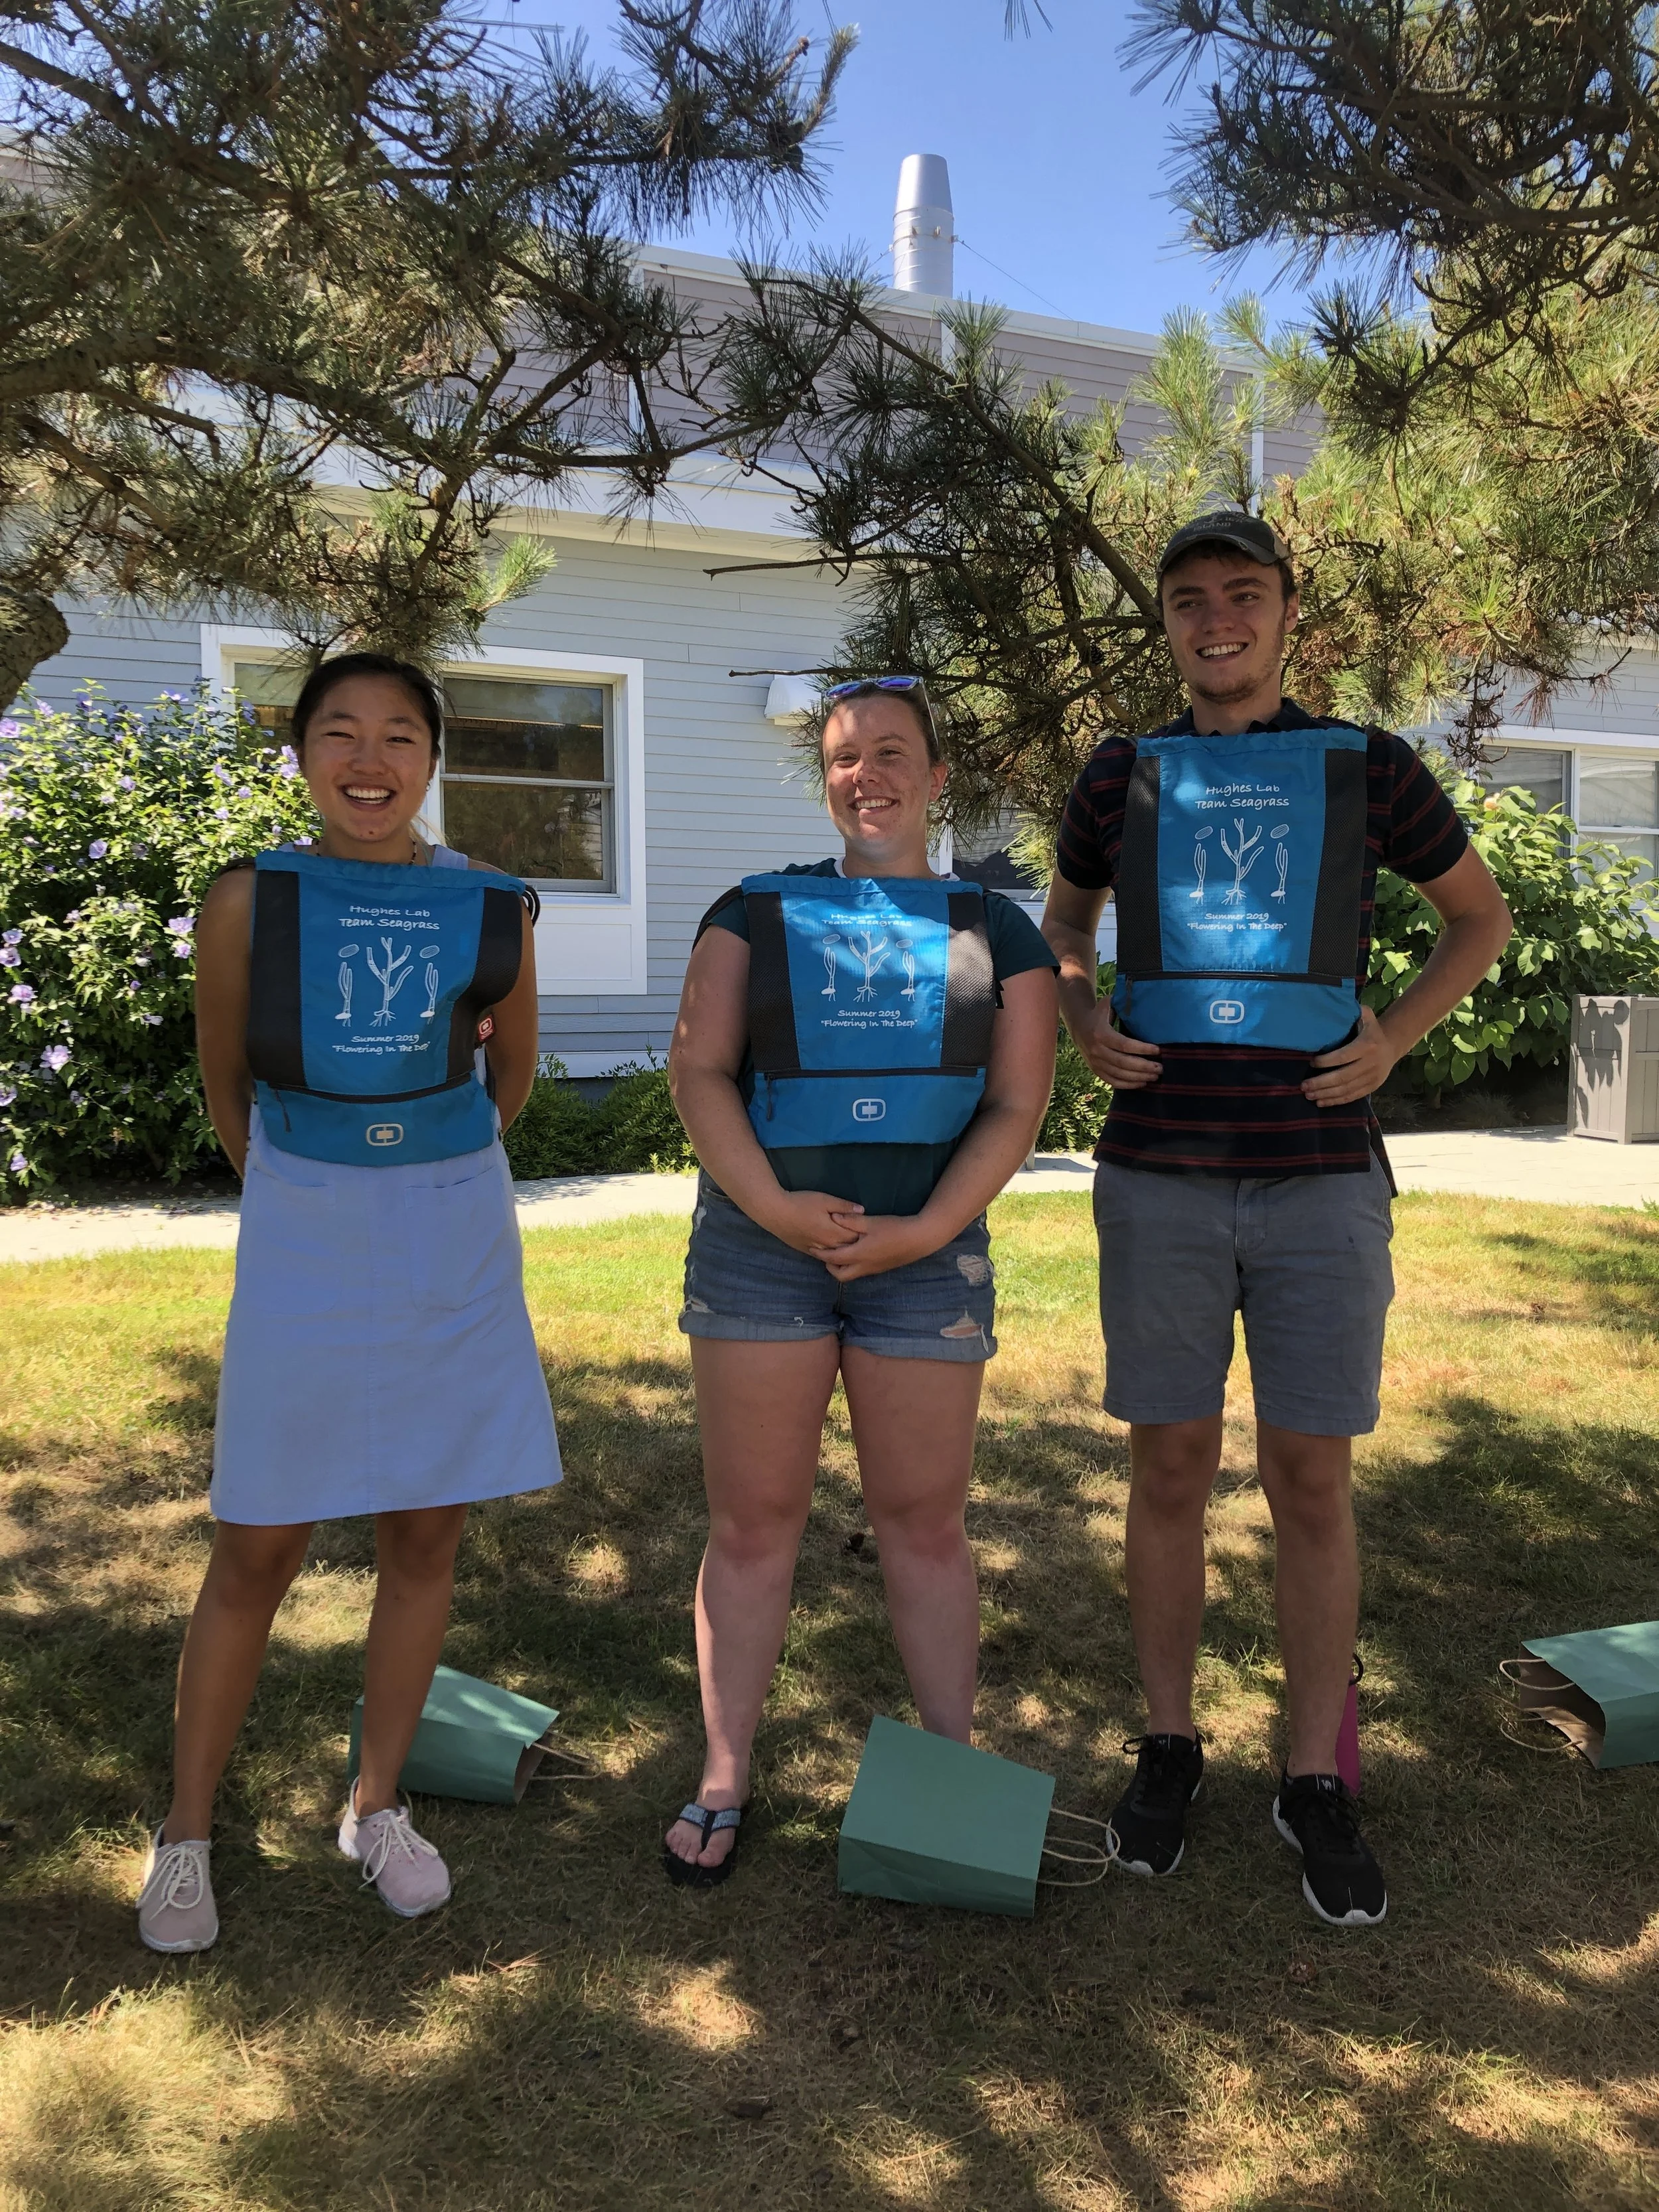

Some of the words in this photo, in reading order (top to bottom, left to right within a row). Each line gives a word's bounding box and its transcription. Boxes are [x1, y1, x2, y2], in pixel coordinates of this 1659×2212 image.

[1206, 782, 1252, 796] Hughes
[1256, 784, 1280, 792] Lab
[1194, 800, 1227, 809] Team
[1230, 798, 1289, 810] Seagrass
[1246, 913, 1269, 922] 2019
[338, 918, 375, 927] Team
[376, 919, 440, 931] Seagrass
[1187, 921, 1234, 932] "Flowering
[1263, 922, 1287, 932] Deep"
[878, 1009, 901, 1019] 2019
[821, 1018, 867, 1029] "Flowering
[881, 1019, 895, 1027] The
[896, 1019, 918, 1029] Deep"
[395, 1034, 419, 1044] 2019
